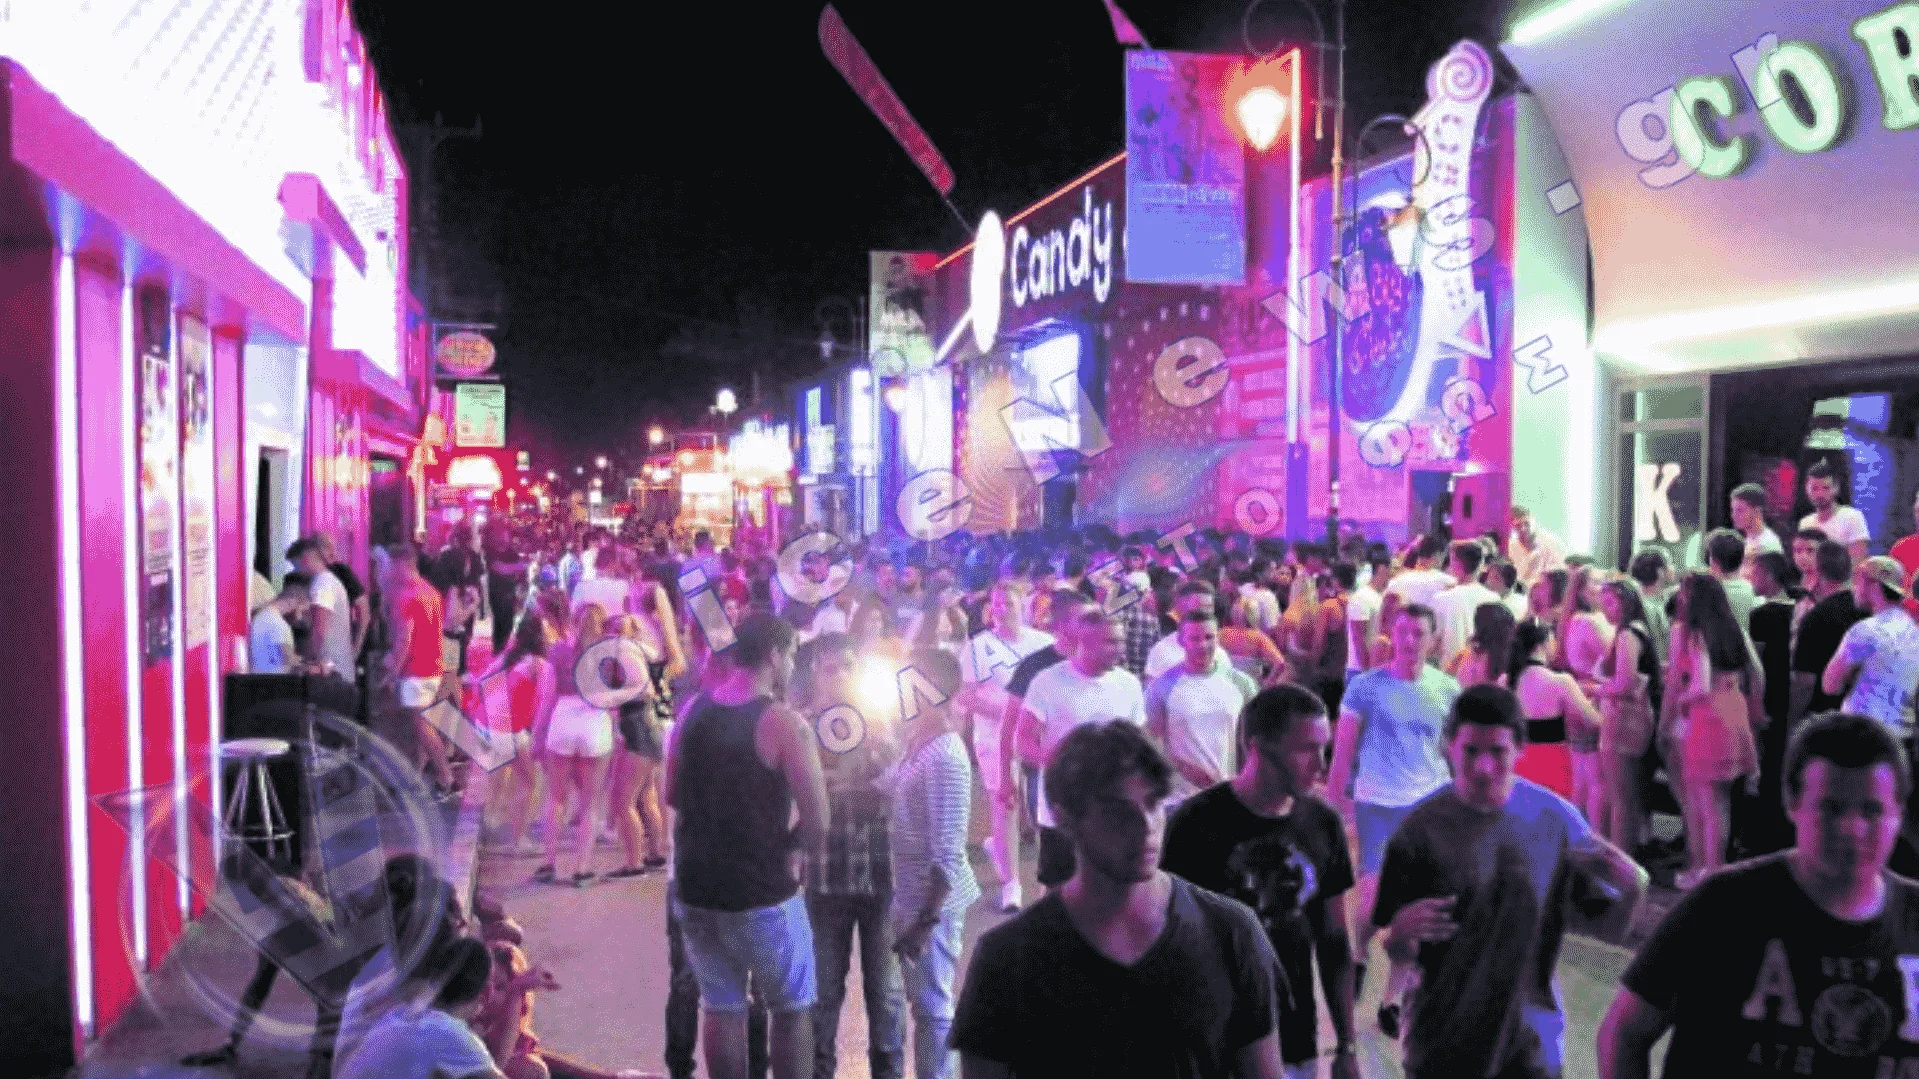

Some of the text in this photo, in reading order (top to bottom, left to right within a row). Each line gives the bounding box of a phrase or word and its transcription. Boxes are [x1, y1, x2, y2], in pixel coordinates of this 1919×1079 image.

[1011, 184, 1112, 307] Candy
[1634, 463, 1681, 543] K
[1741, 938, 1803, 1027] A
